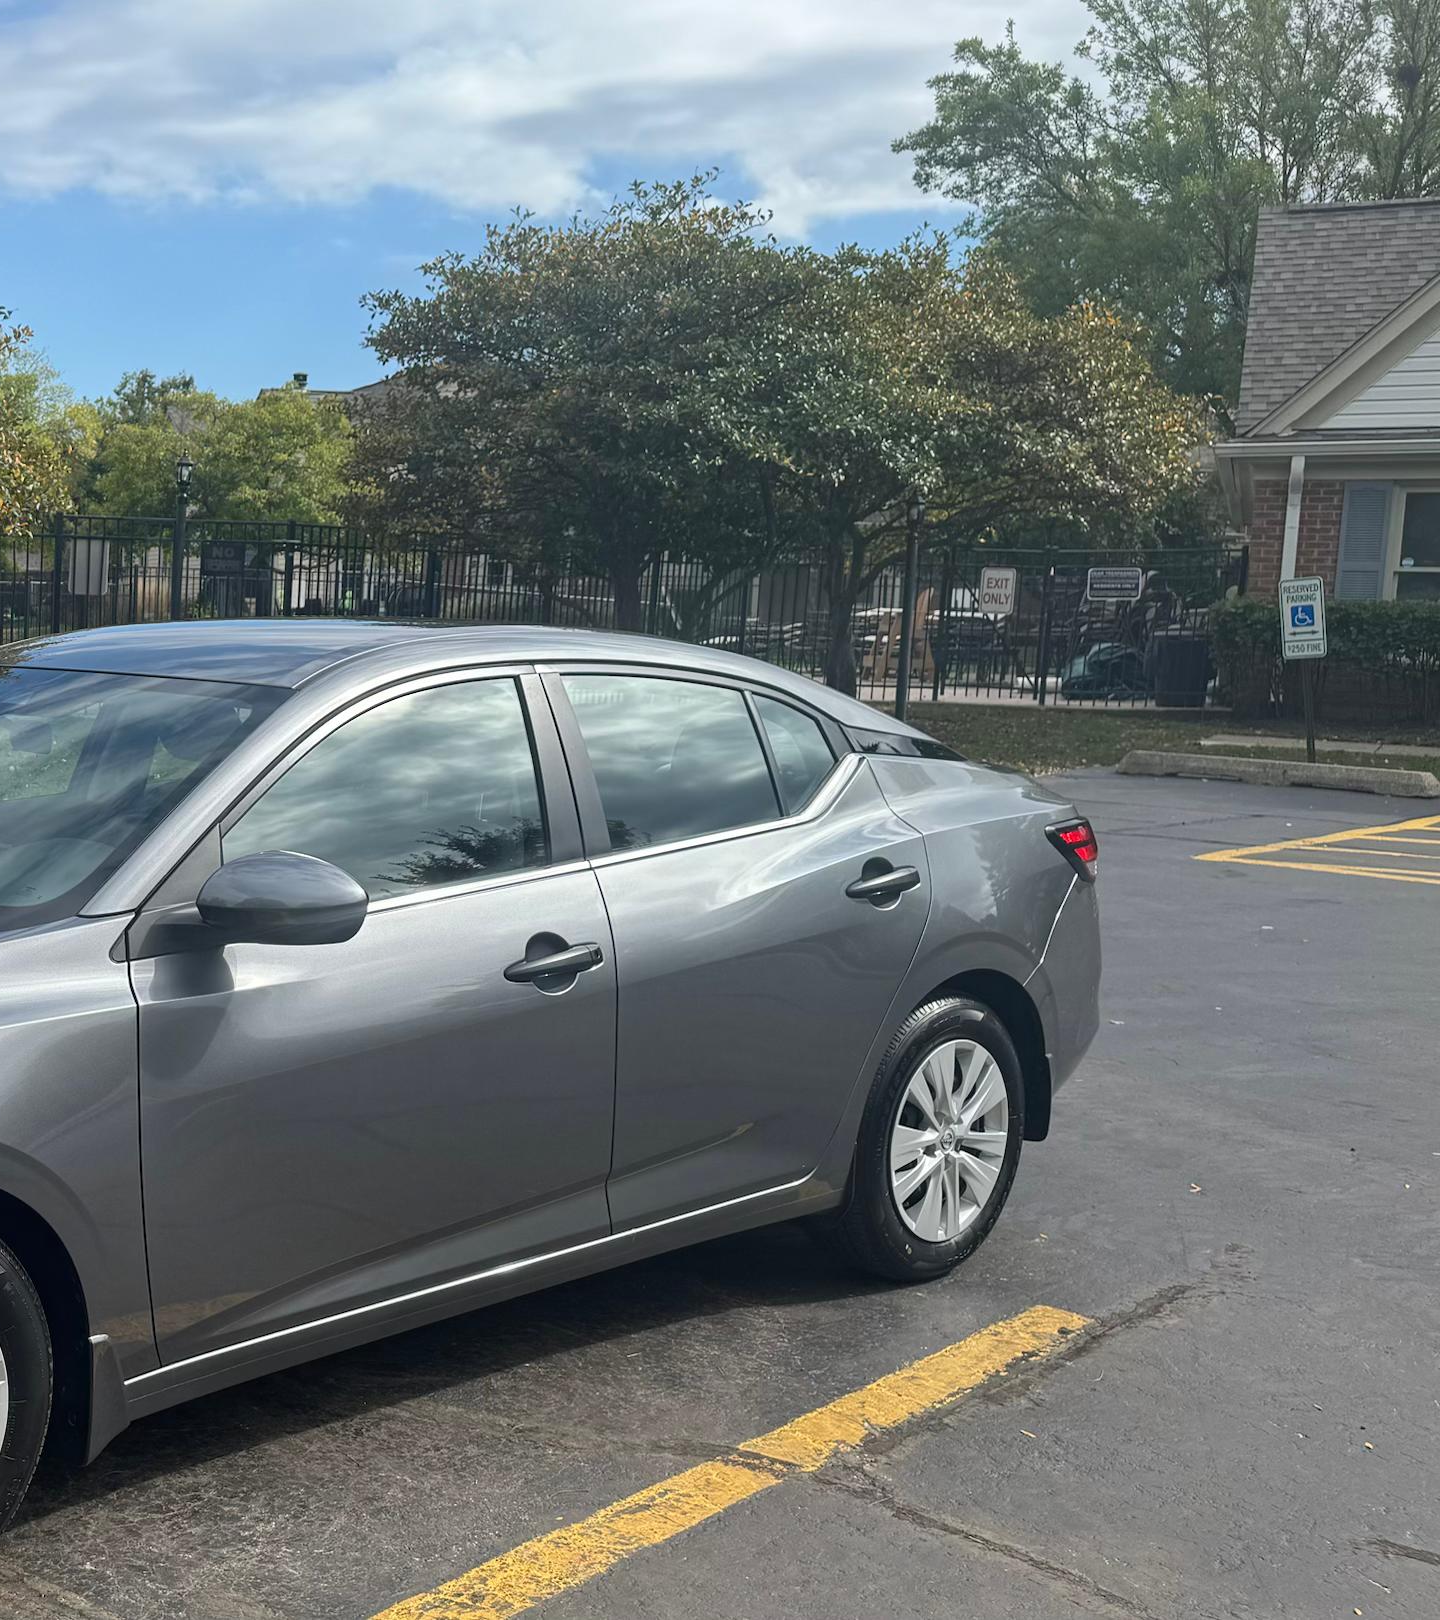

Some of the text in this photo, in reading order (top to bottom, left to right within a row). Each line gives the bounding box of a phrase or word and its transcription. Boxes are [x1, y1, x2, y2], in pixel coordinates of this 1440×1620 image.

[211, 546, 234, 558] NO
[986, 577, 1009, 589] EXIT
[1283, 583, 1319, 593] RESERVED
[983, 592, 1011, 605] ONLY
[1286, 592, 1317, 603] PARKING
[1306, 642, 1323, 653] FINE
